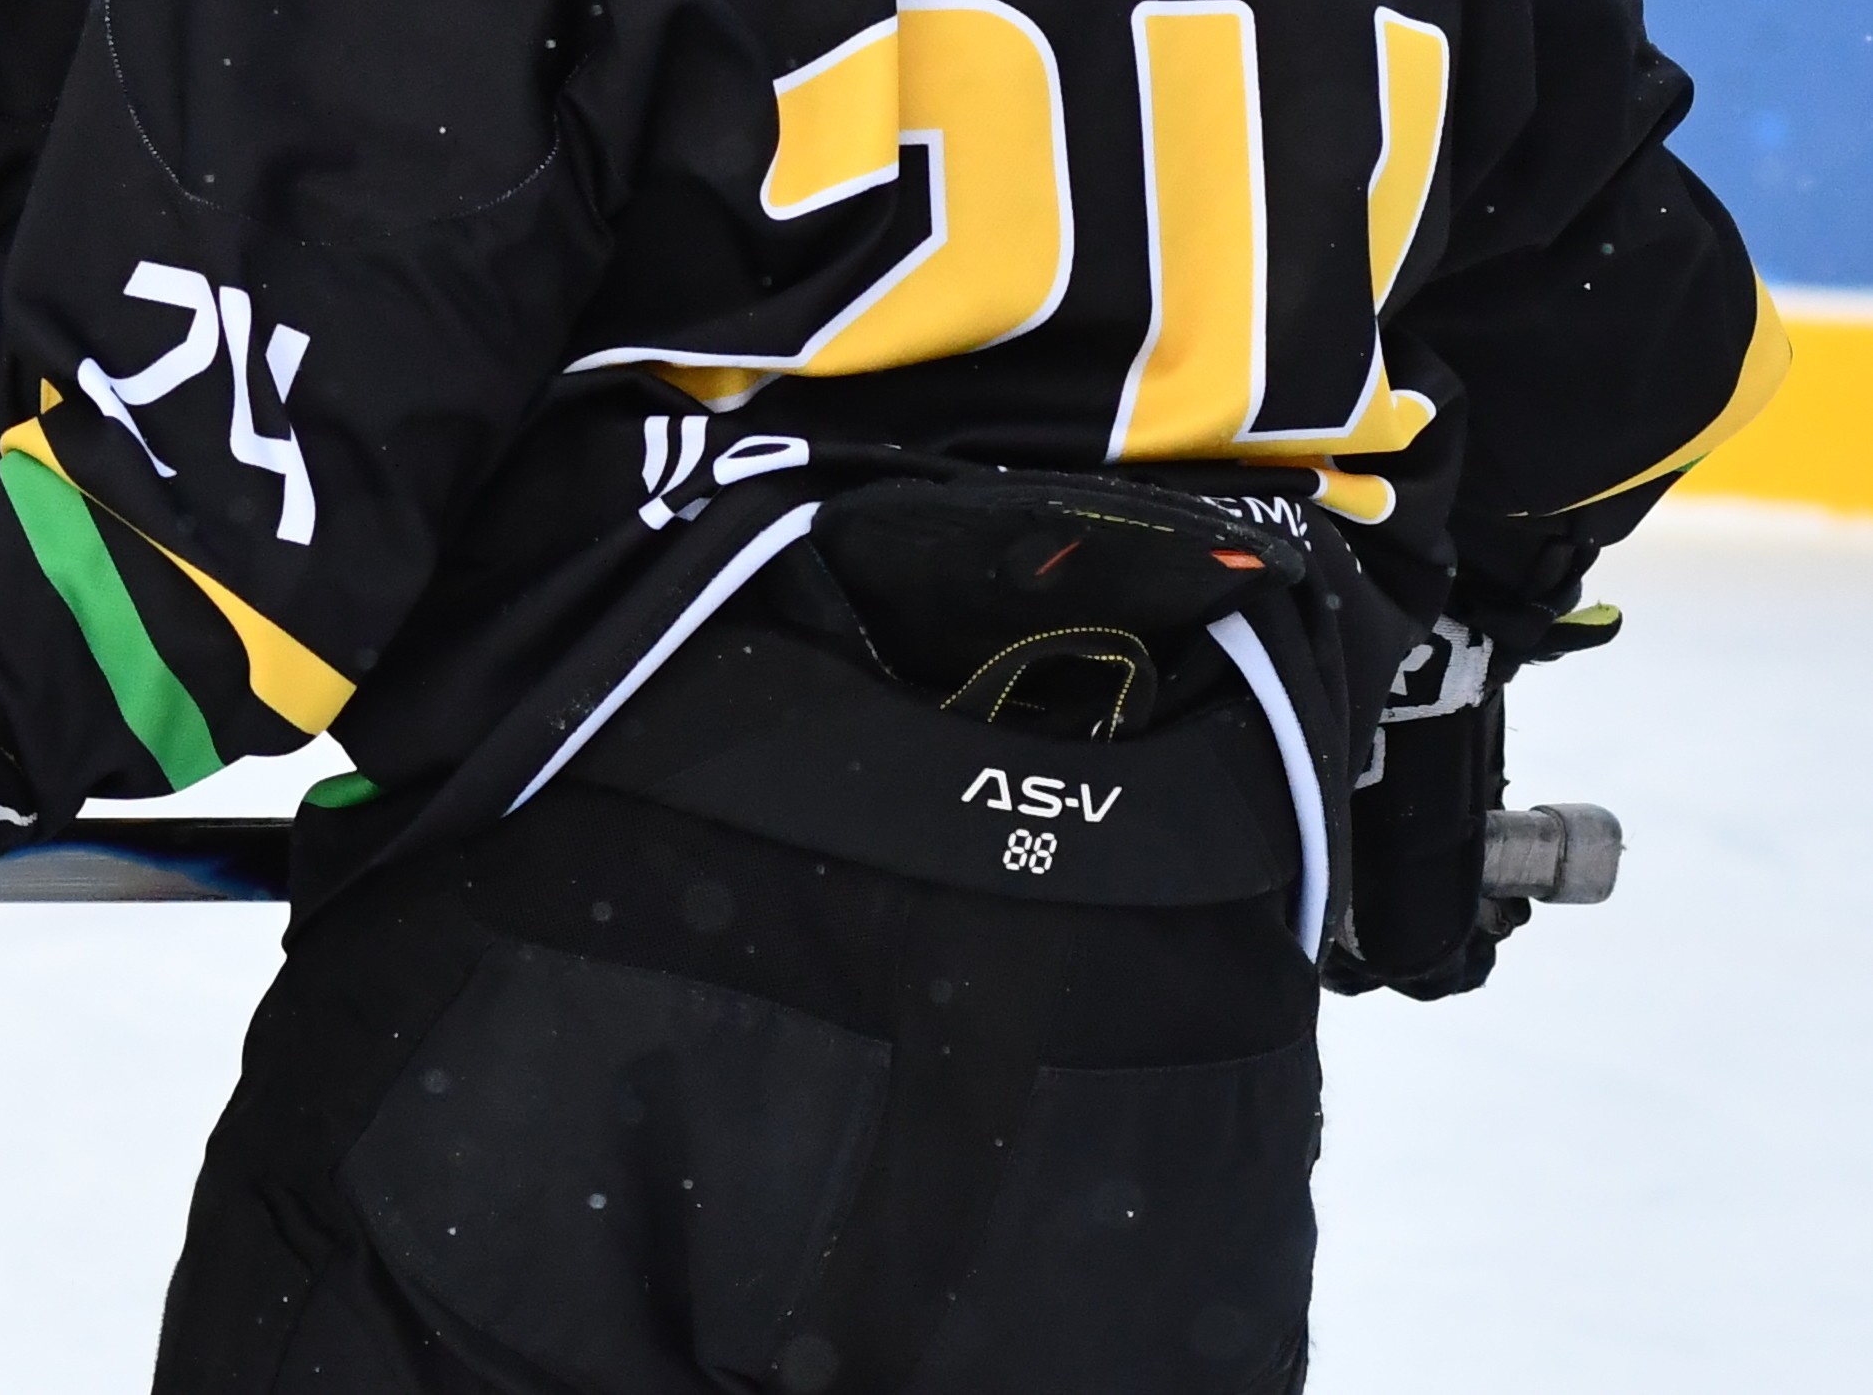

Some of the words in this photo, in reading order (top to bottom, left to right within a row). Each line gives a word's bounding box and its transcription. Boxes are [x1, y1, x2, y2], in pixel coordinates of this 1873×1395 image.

[77, 261, 316, 546] 24
[961, 767, 1123, 823] AS-V
[1002, 828, 1058, 875] 88
